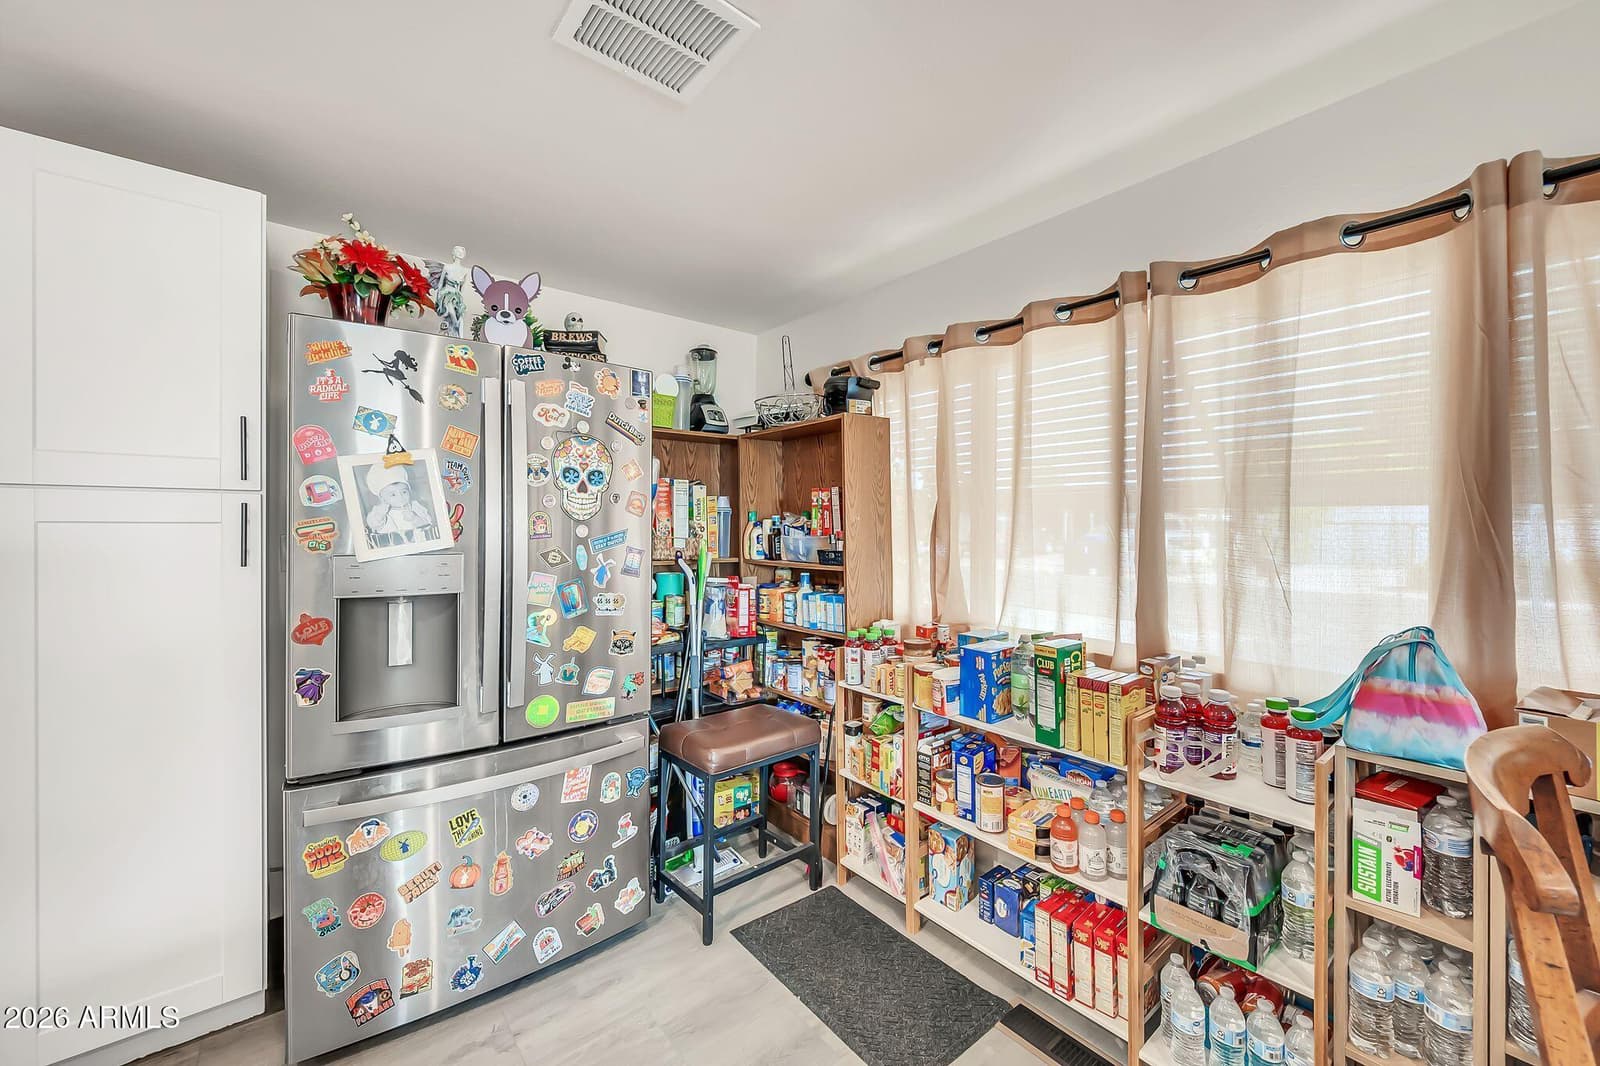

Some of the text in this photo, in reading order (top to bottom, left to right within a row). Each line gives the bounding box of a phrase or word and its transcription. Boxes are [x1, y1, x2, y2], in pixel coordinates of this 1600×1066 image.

[551, 331, 593, 342] BREWS
[310, 383, 348, 393] RADICAL
[295, 621, 328, 638] LOVE
[1036, 657, 1055, 670] CLUB
[449, 808, 477, 831] LOVE
[304, 842, 342, 860] GOOD
[1357, 843, 1377, 895] SUSTAIN
